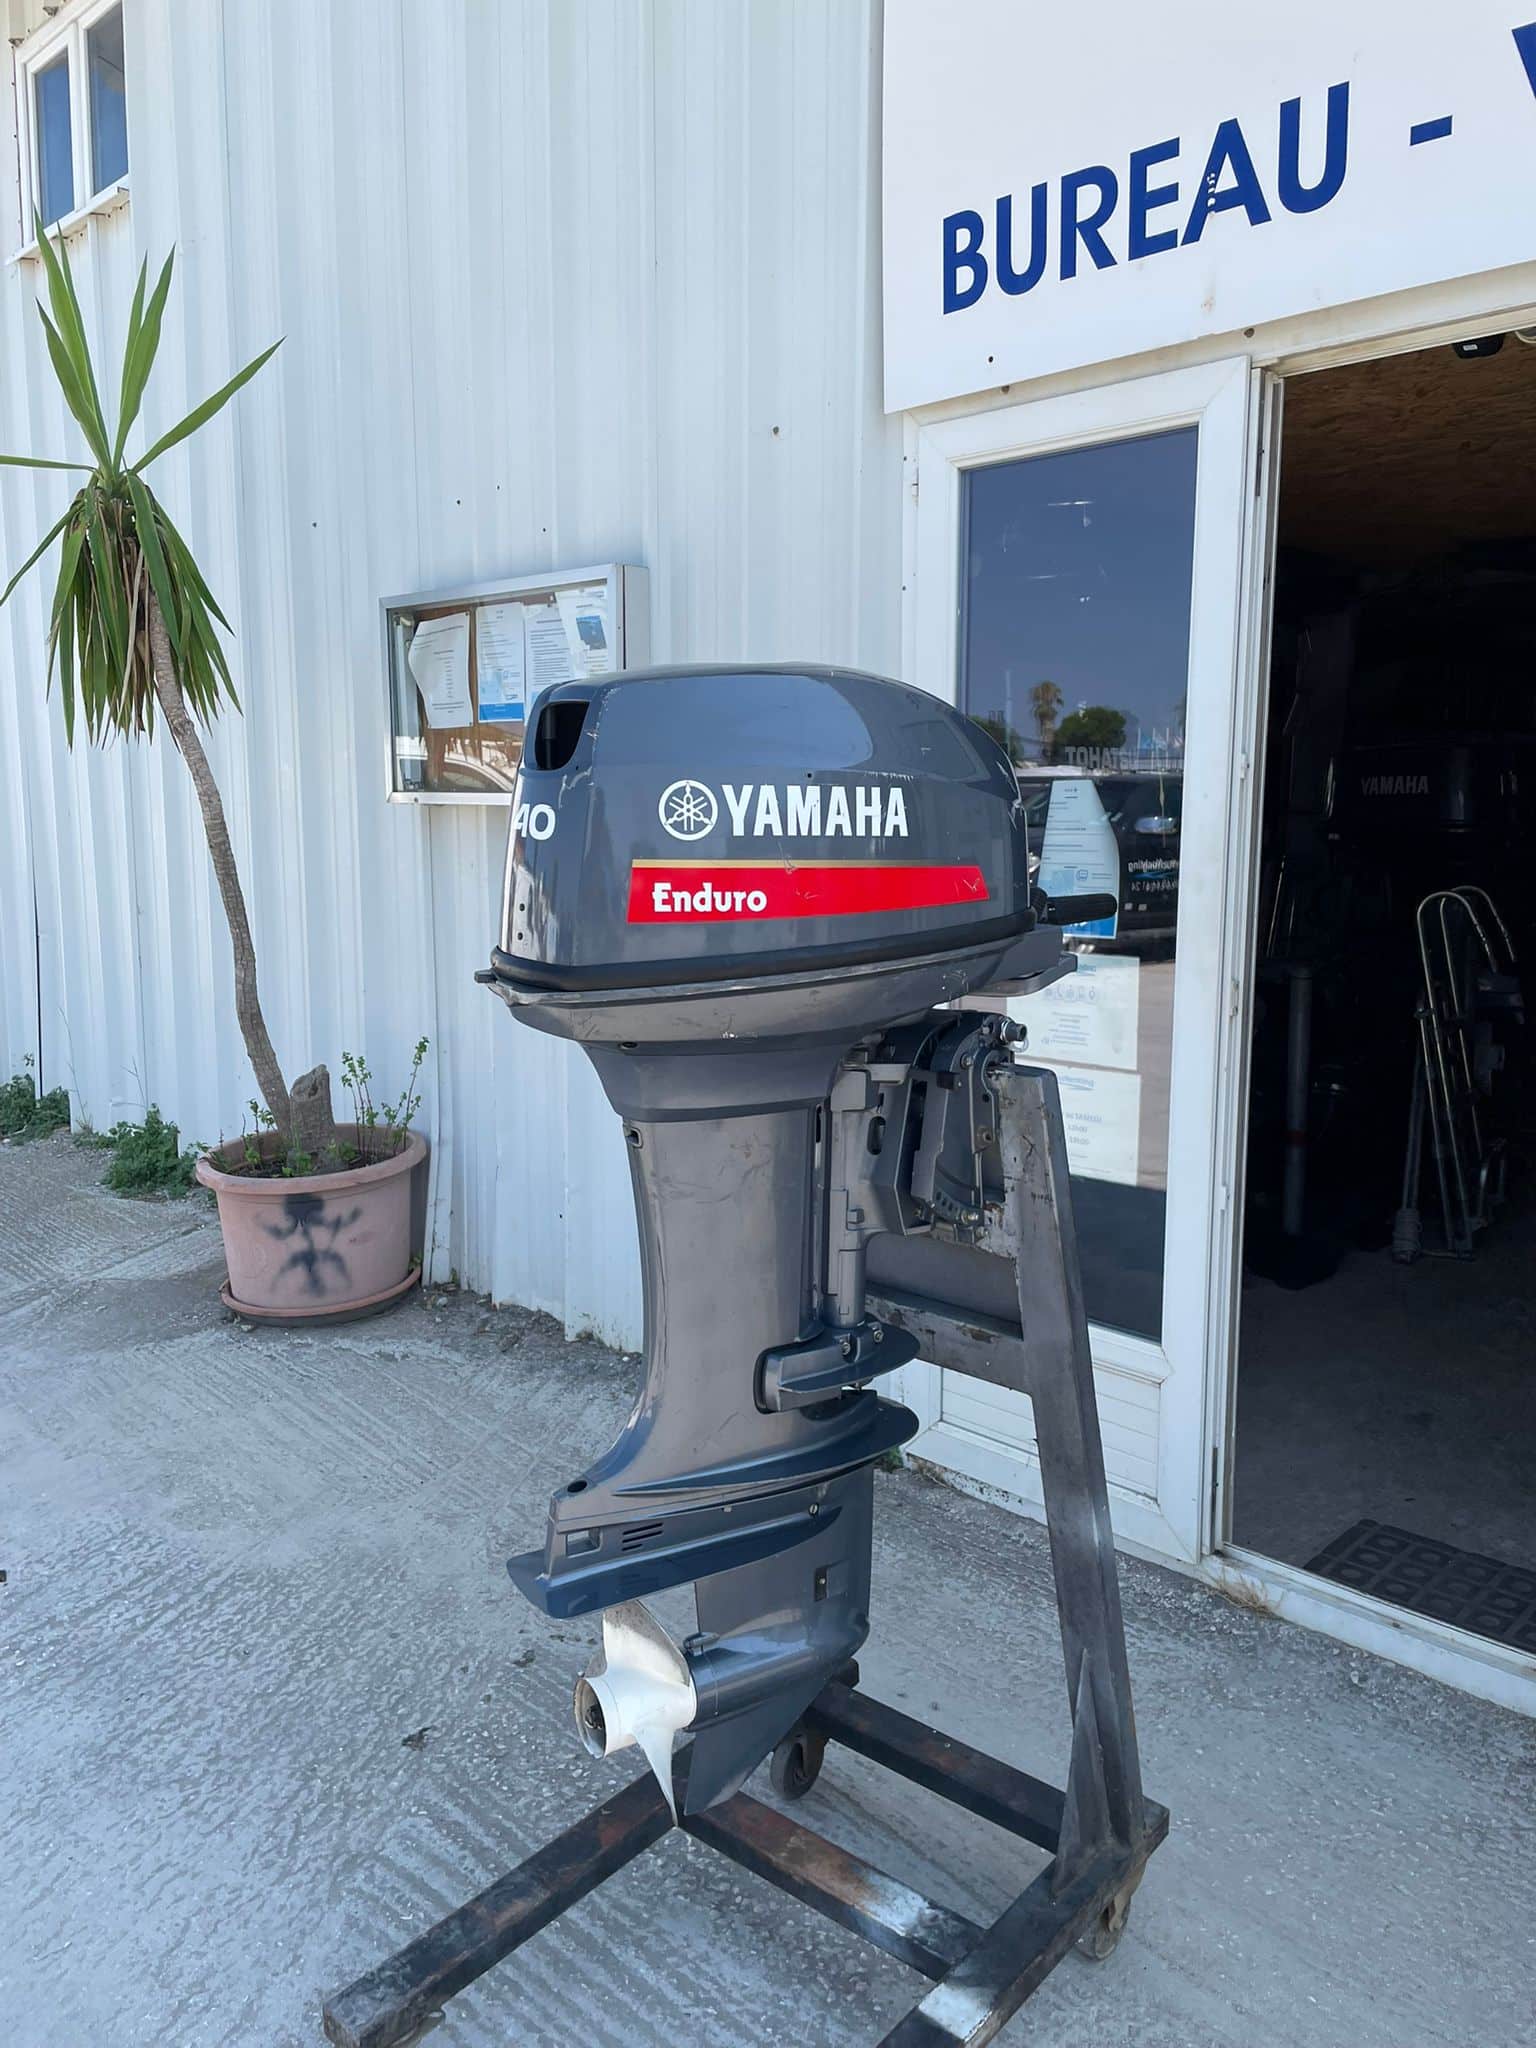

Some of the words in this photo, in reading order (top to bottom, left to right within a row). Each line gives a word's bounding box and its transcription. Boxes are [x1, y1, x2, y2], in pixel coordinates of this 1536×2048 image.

[943, 81, 1350, 315] BUREAU
[1361, 775, 1429, 796] YAMAHA
[512, 802, 556, 841] 40
[721, 784, 909, 837] YAMAHA
[651, 882, 768, 913] Enduro
